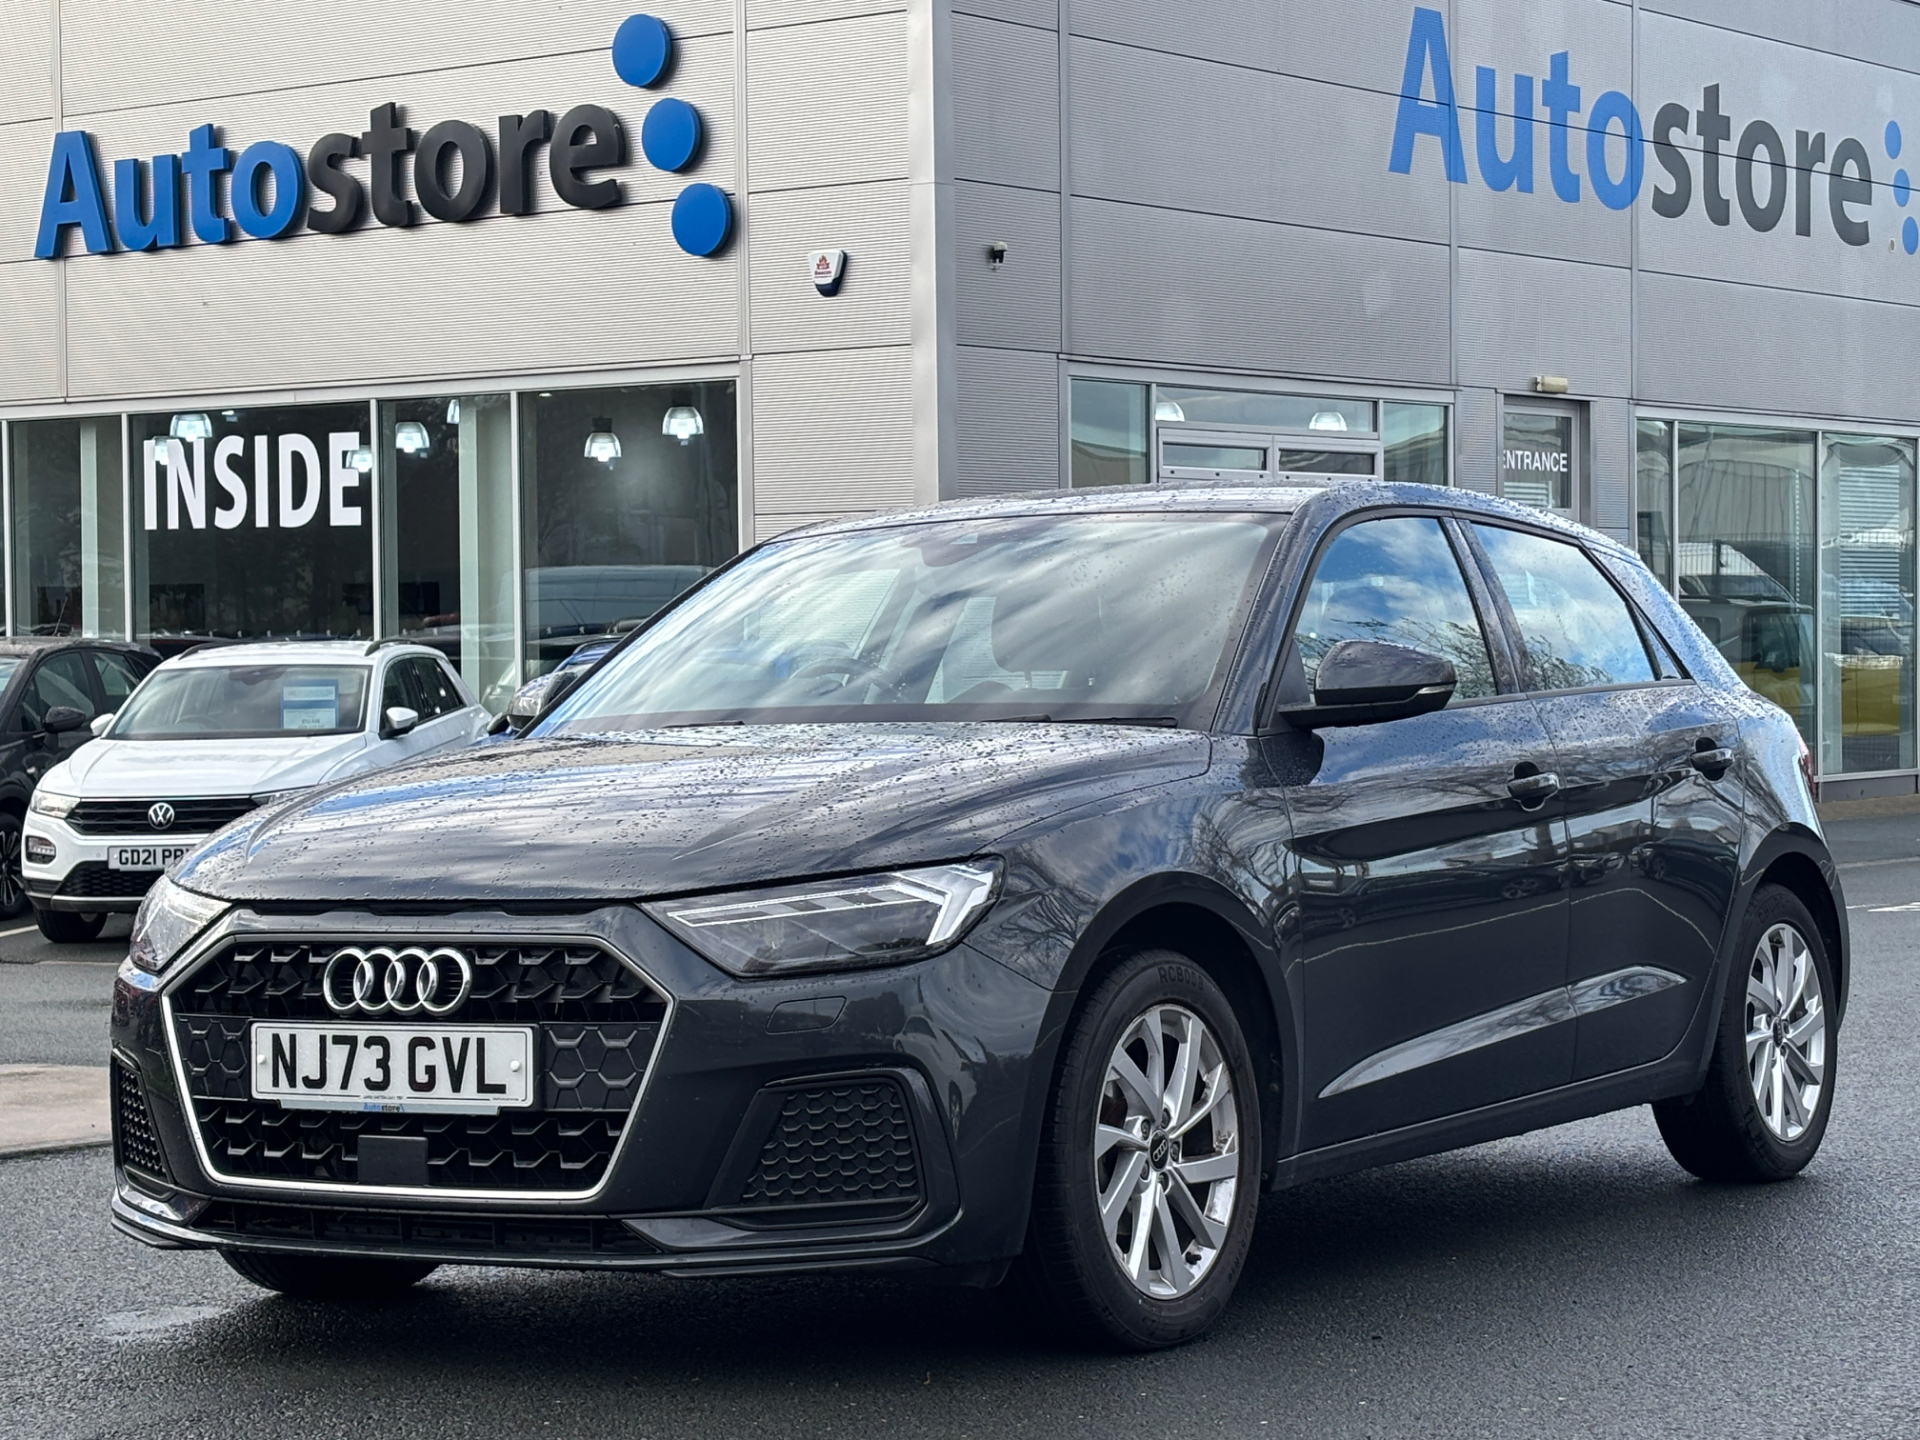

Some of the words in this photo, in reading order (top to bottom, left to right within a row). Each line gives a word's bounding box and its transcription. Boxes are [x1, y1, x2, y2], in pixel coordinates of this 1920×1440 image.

[1388, 6, 1873, 247] Autostore
[34, 101, 628, 259] Autostore
[143, 431, 363, 531] INSIDE
[119, 849, 157, 866] GD21
[271, 1032, 391, 1091] NJ73
[407, 1036, 508, 1095] GVL
